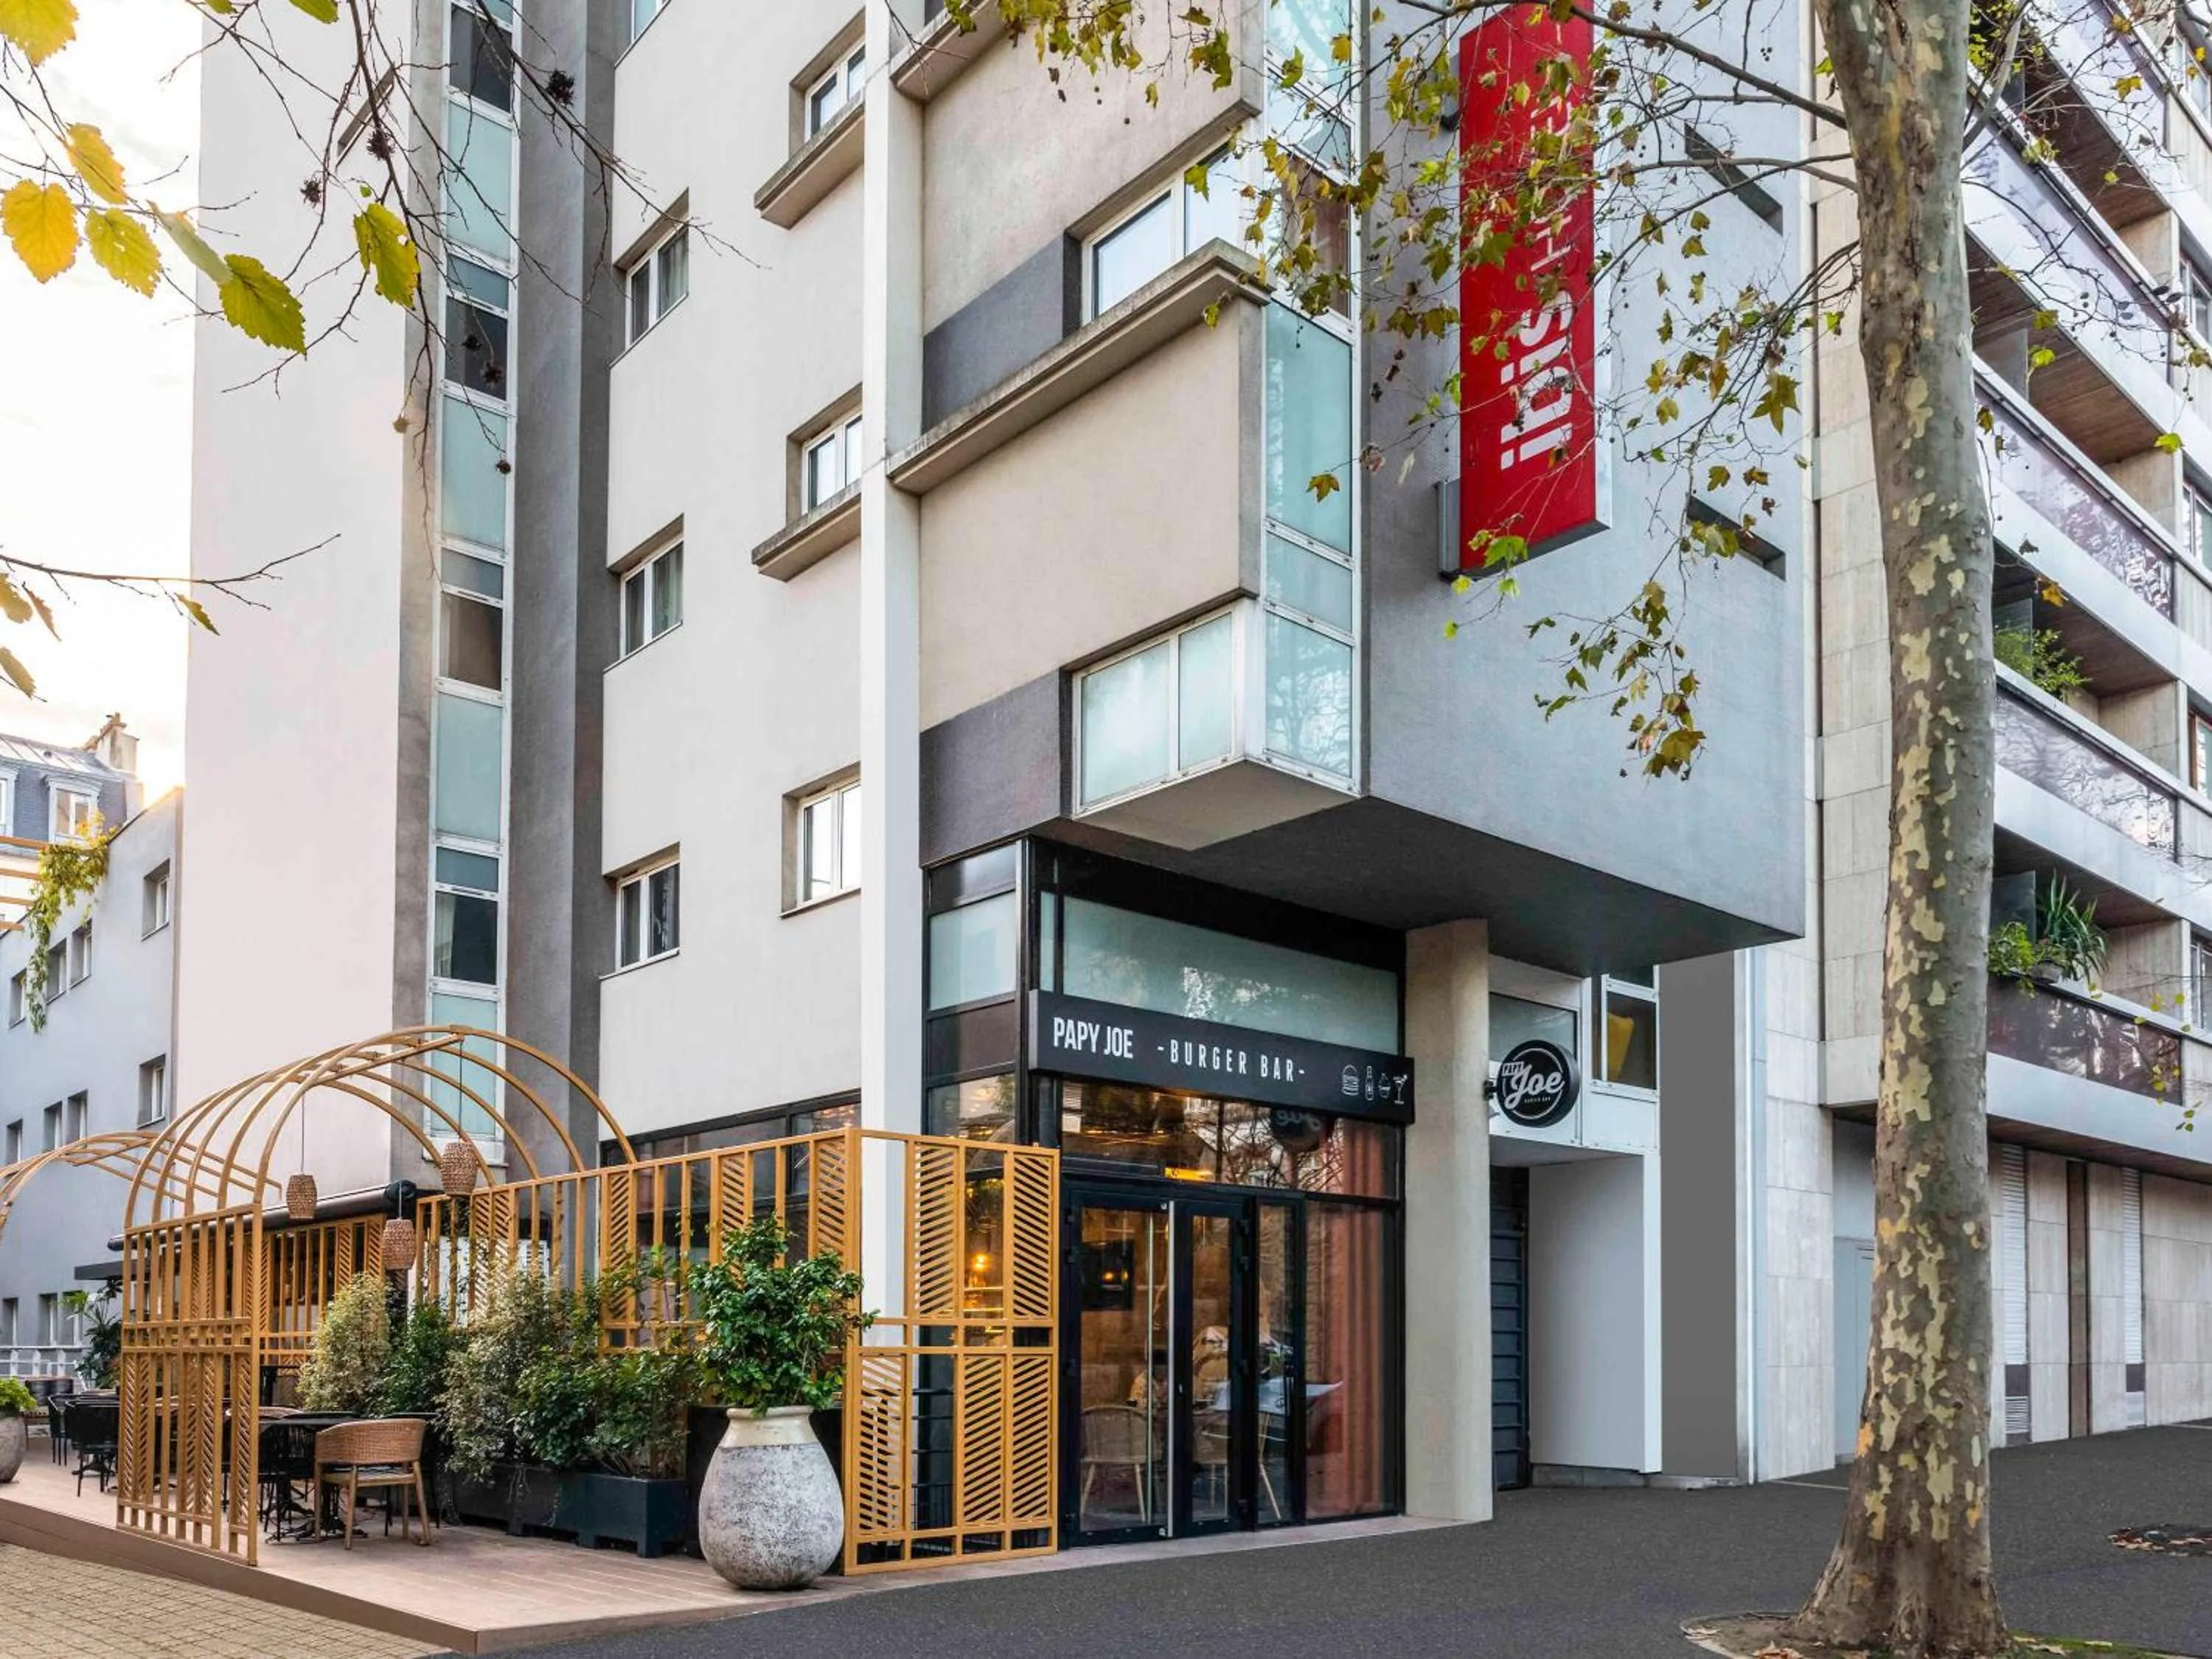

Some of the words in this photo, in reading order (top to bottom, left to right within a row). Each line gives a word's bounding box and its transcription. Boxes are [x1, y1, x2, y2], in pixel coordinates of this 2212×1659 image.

[1500, 291, 1572, 470] ibis
[1053, 1017, 1101, 1053] PAPY
[1104, 1026, 1133, 1059] JOE
[1503, 1062, 1522, 1074] PAPY
[1504, 1064, 1565, 1109] Joe
